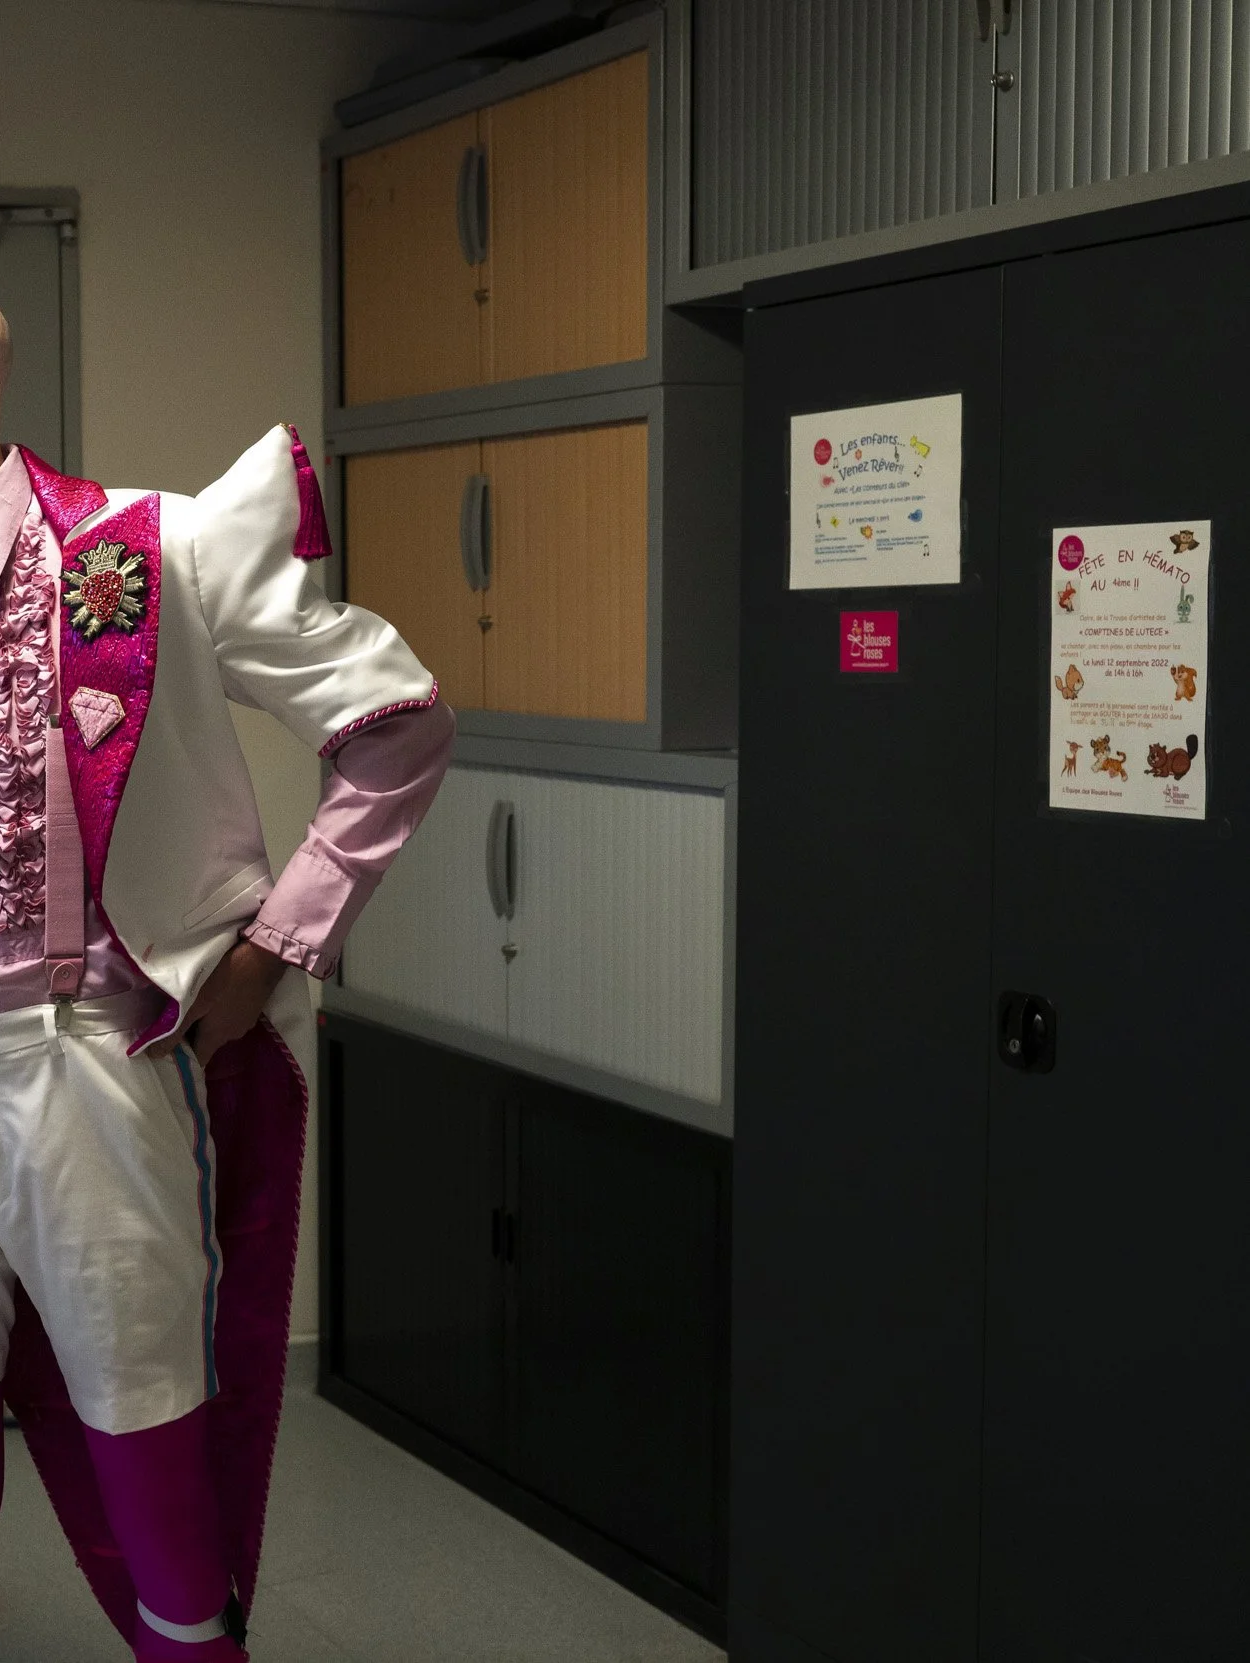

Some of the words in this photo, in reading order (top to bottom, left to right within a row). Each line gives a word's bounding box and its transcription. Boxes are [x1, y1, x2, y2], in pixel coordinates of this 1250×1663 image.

[840, 439, 858, 456] Les
[838, 461, 869, 481] Venez
[1078, 554, 1105, 579] FÊTE
[1118, 550, 1134, 563] EN
[1143, 550, 1191, 584] HÉMATO
[1090, 579, 1106, 592] AU
[1112, 578, 1131, 588] 4ème
[863, 619, 875, 633] les
[1084, 628, 1124, 636] COMPTINES
[1125, 628, 1134, 636] DE
[863, 634, 891, 647] blouses
[863, 648, 883, 660] roses
[1116, 659, 1150, 668] septembre
[1151, 659, 1169, 667] 2022
[1114, 669, 1125, 677] 14h
